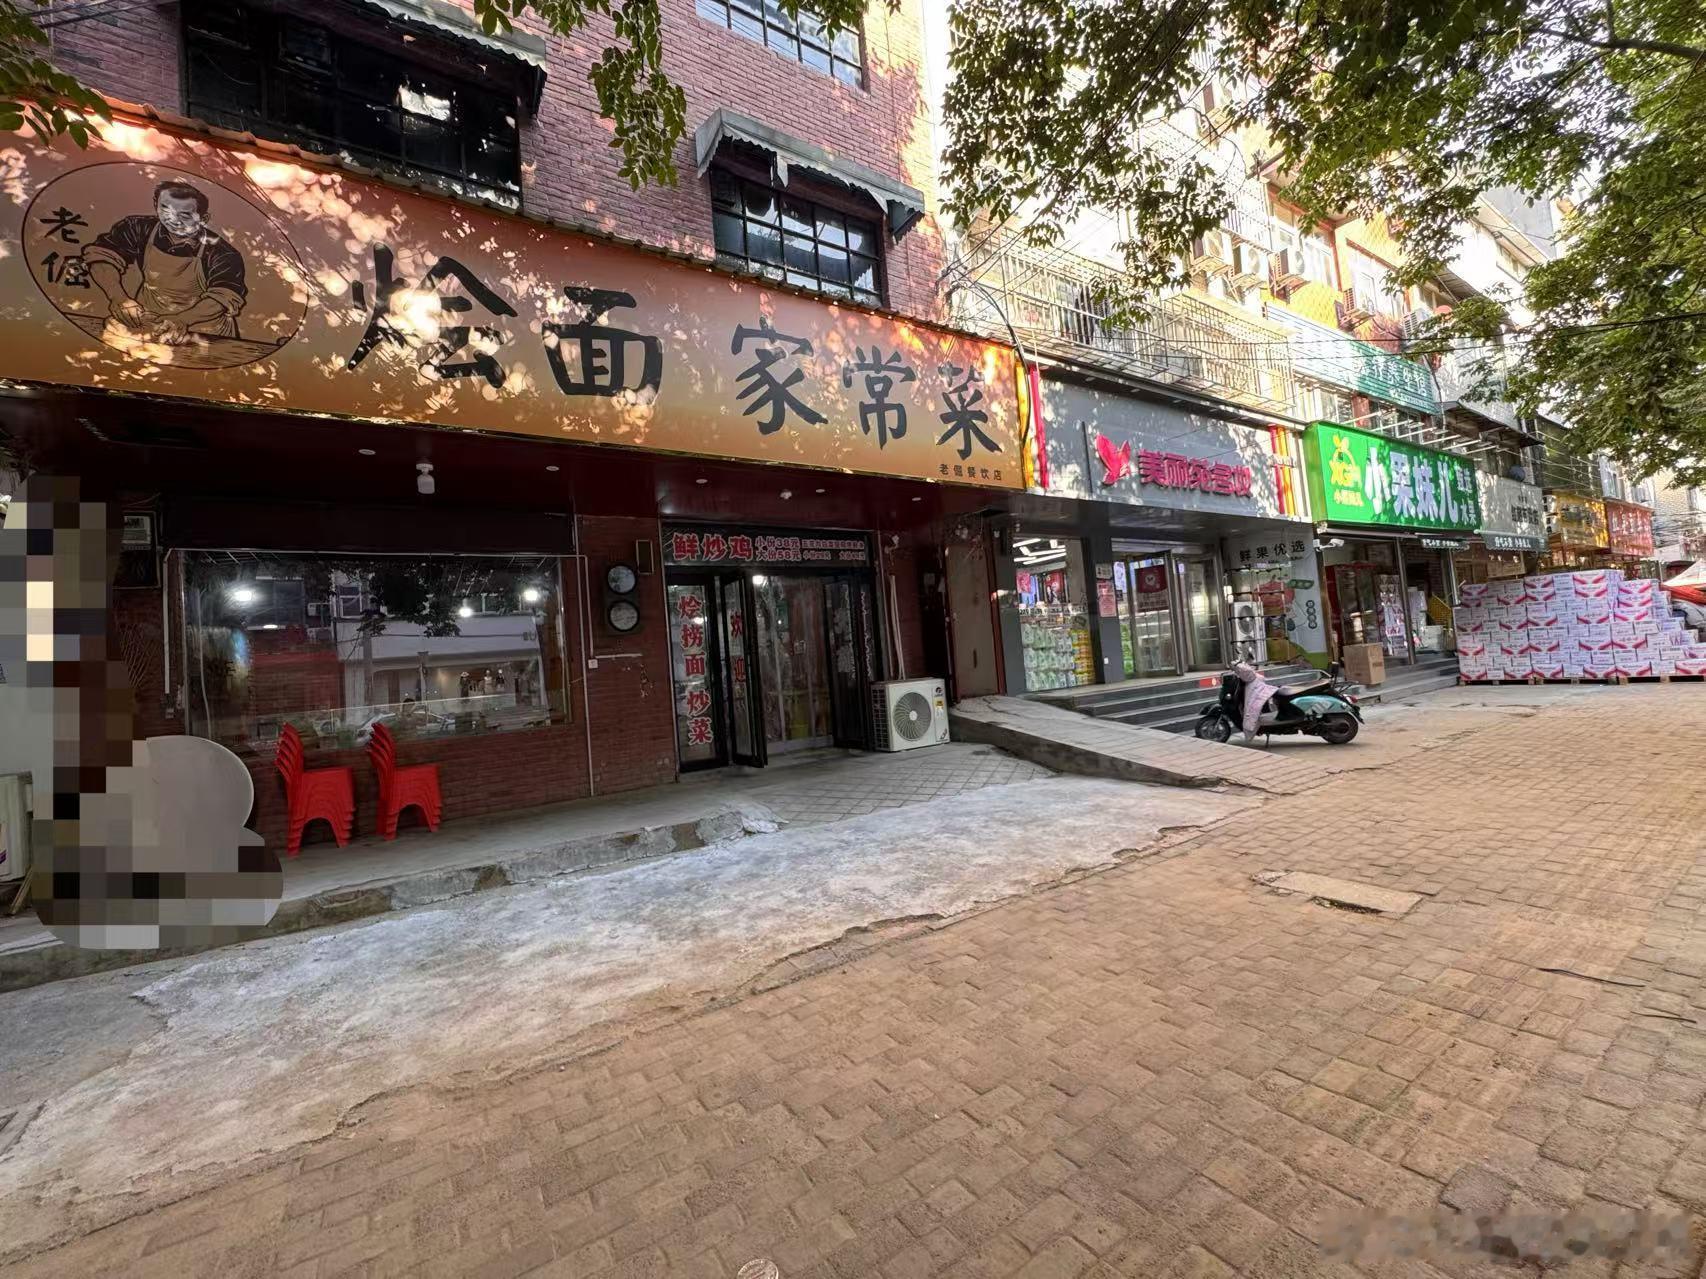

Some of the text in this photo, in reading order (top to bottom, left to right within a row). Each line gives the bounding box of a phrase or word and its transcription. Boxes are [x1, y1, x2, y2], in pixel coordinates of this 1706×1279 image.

[1364, 446, 1459, 524] 小果妹儿
[671, 533, 753, 562] 鲜炒鸡
[754, 535, 800, 549] 小份38元
[755, 548, 802, 562] 大份58元
[677, 595, 714, 746] 烩捞面炒菜
